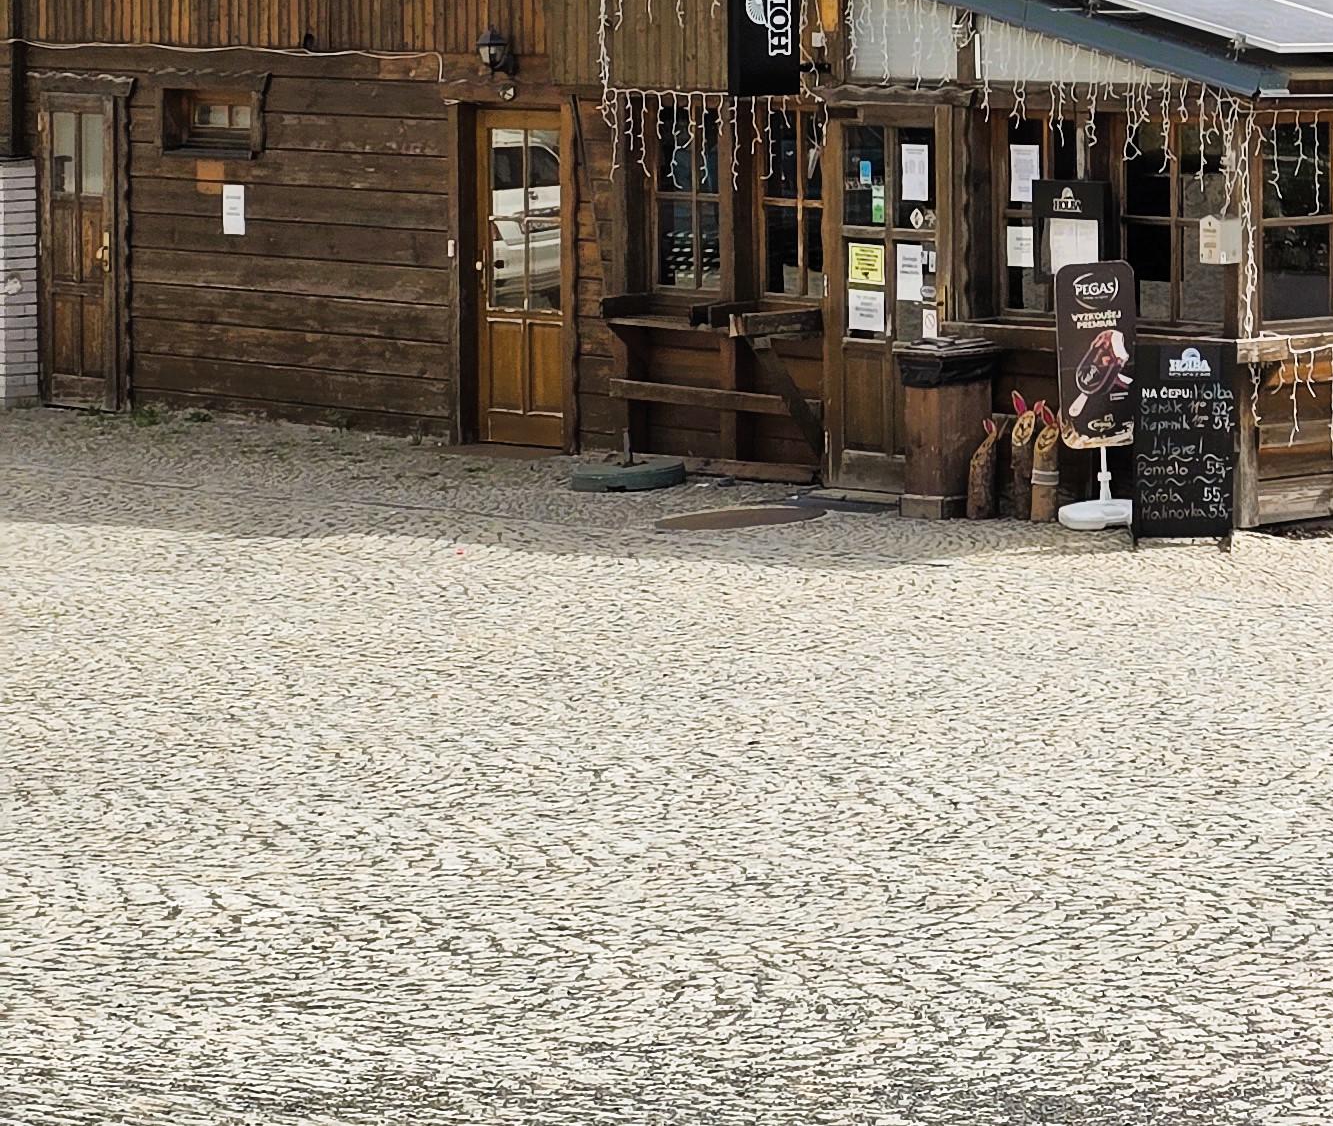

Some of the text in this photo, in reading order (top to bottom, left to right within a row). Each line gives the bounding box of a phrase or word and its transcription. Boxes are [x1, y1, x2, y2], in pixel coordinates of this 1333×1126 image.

[1075, 282, 1115, 296] PEGAS
[1141, 387, 1158, 399] NA
[1136, 461, 1189, 476] Pomelo
[1140, 487, 1184, 503] Kofola
